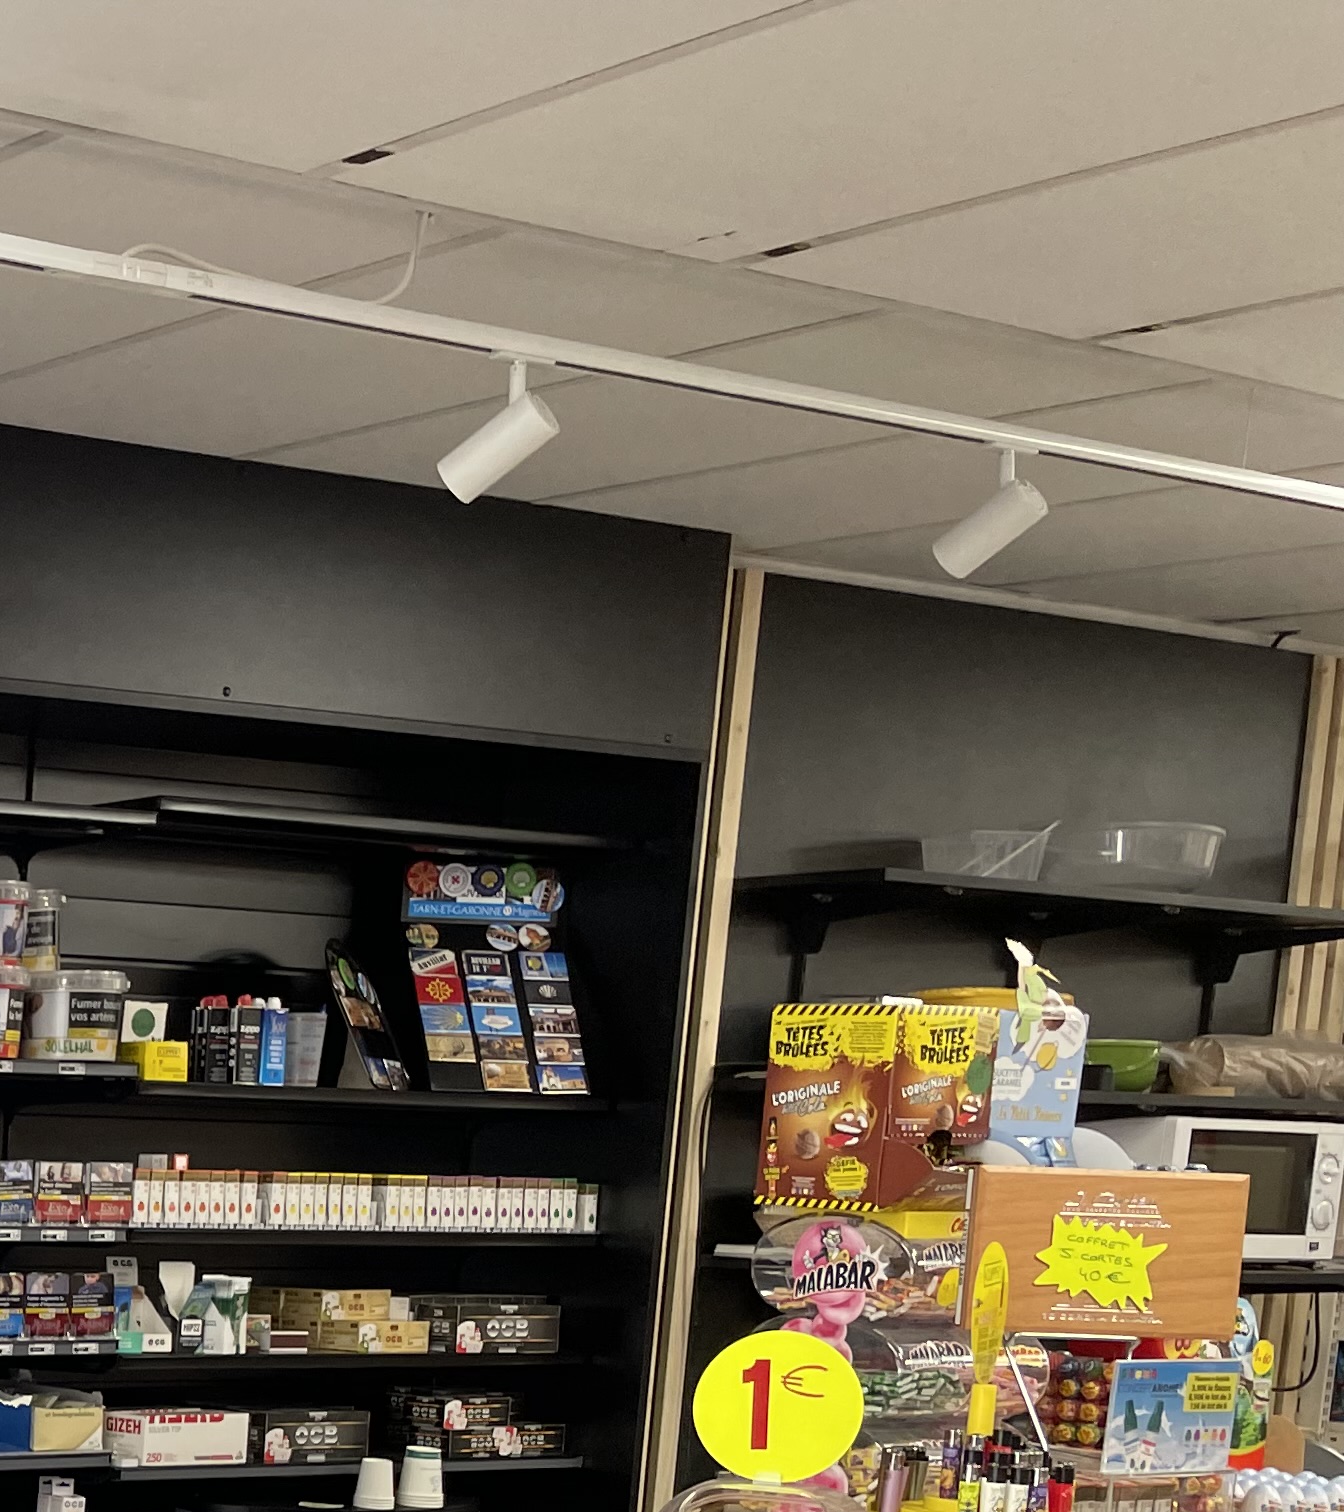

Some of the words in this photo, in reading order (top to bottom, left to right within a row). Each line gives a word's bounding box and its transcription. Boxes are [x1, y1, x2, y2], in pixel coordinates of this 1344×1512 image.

[417, 953, 449, 971] Auvillar
[71, 998, 102, 1010] Fumer
[71, 1012, 87, 1022] vos
[772, 1080, 842, 1107] L'ORIGINALE
[901, 1073, 955, 1099] L'ORIGINALE
[1067, 1233, 1131, 1250] COFFRET
[794, 1260, 878, 1296] MALABAR
[485, 1317, 530, 1339] OCB
[105, 1416, 143, 1435] GIZEH
[294, 1425, 339, 1446] OCB
[145, 1451, 163, 1463] 250
[64, 1499, 85, 1509] OCB
